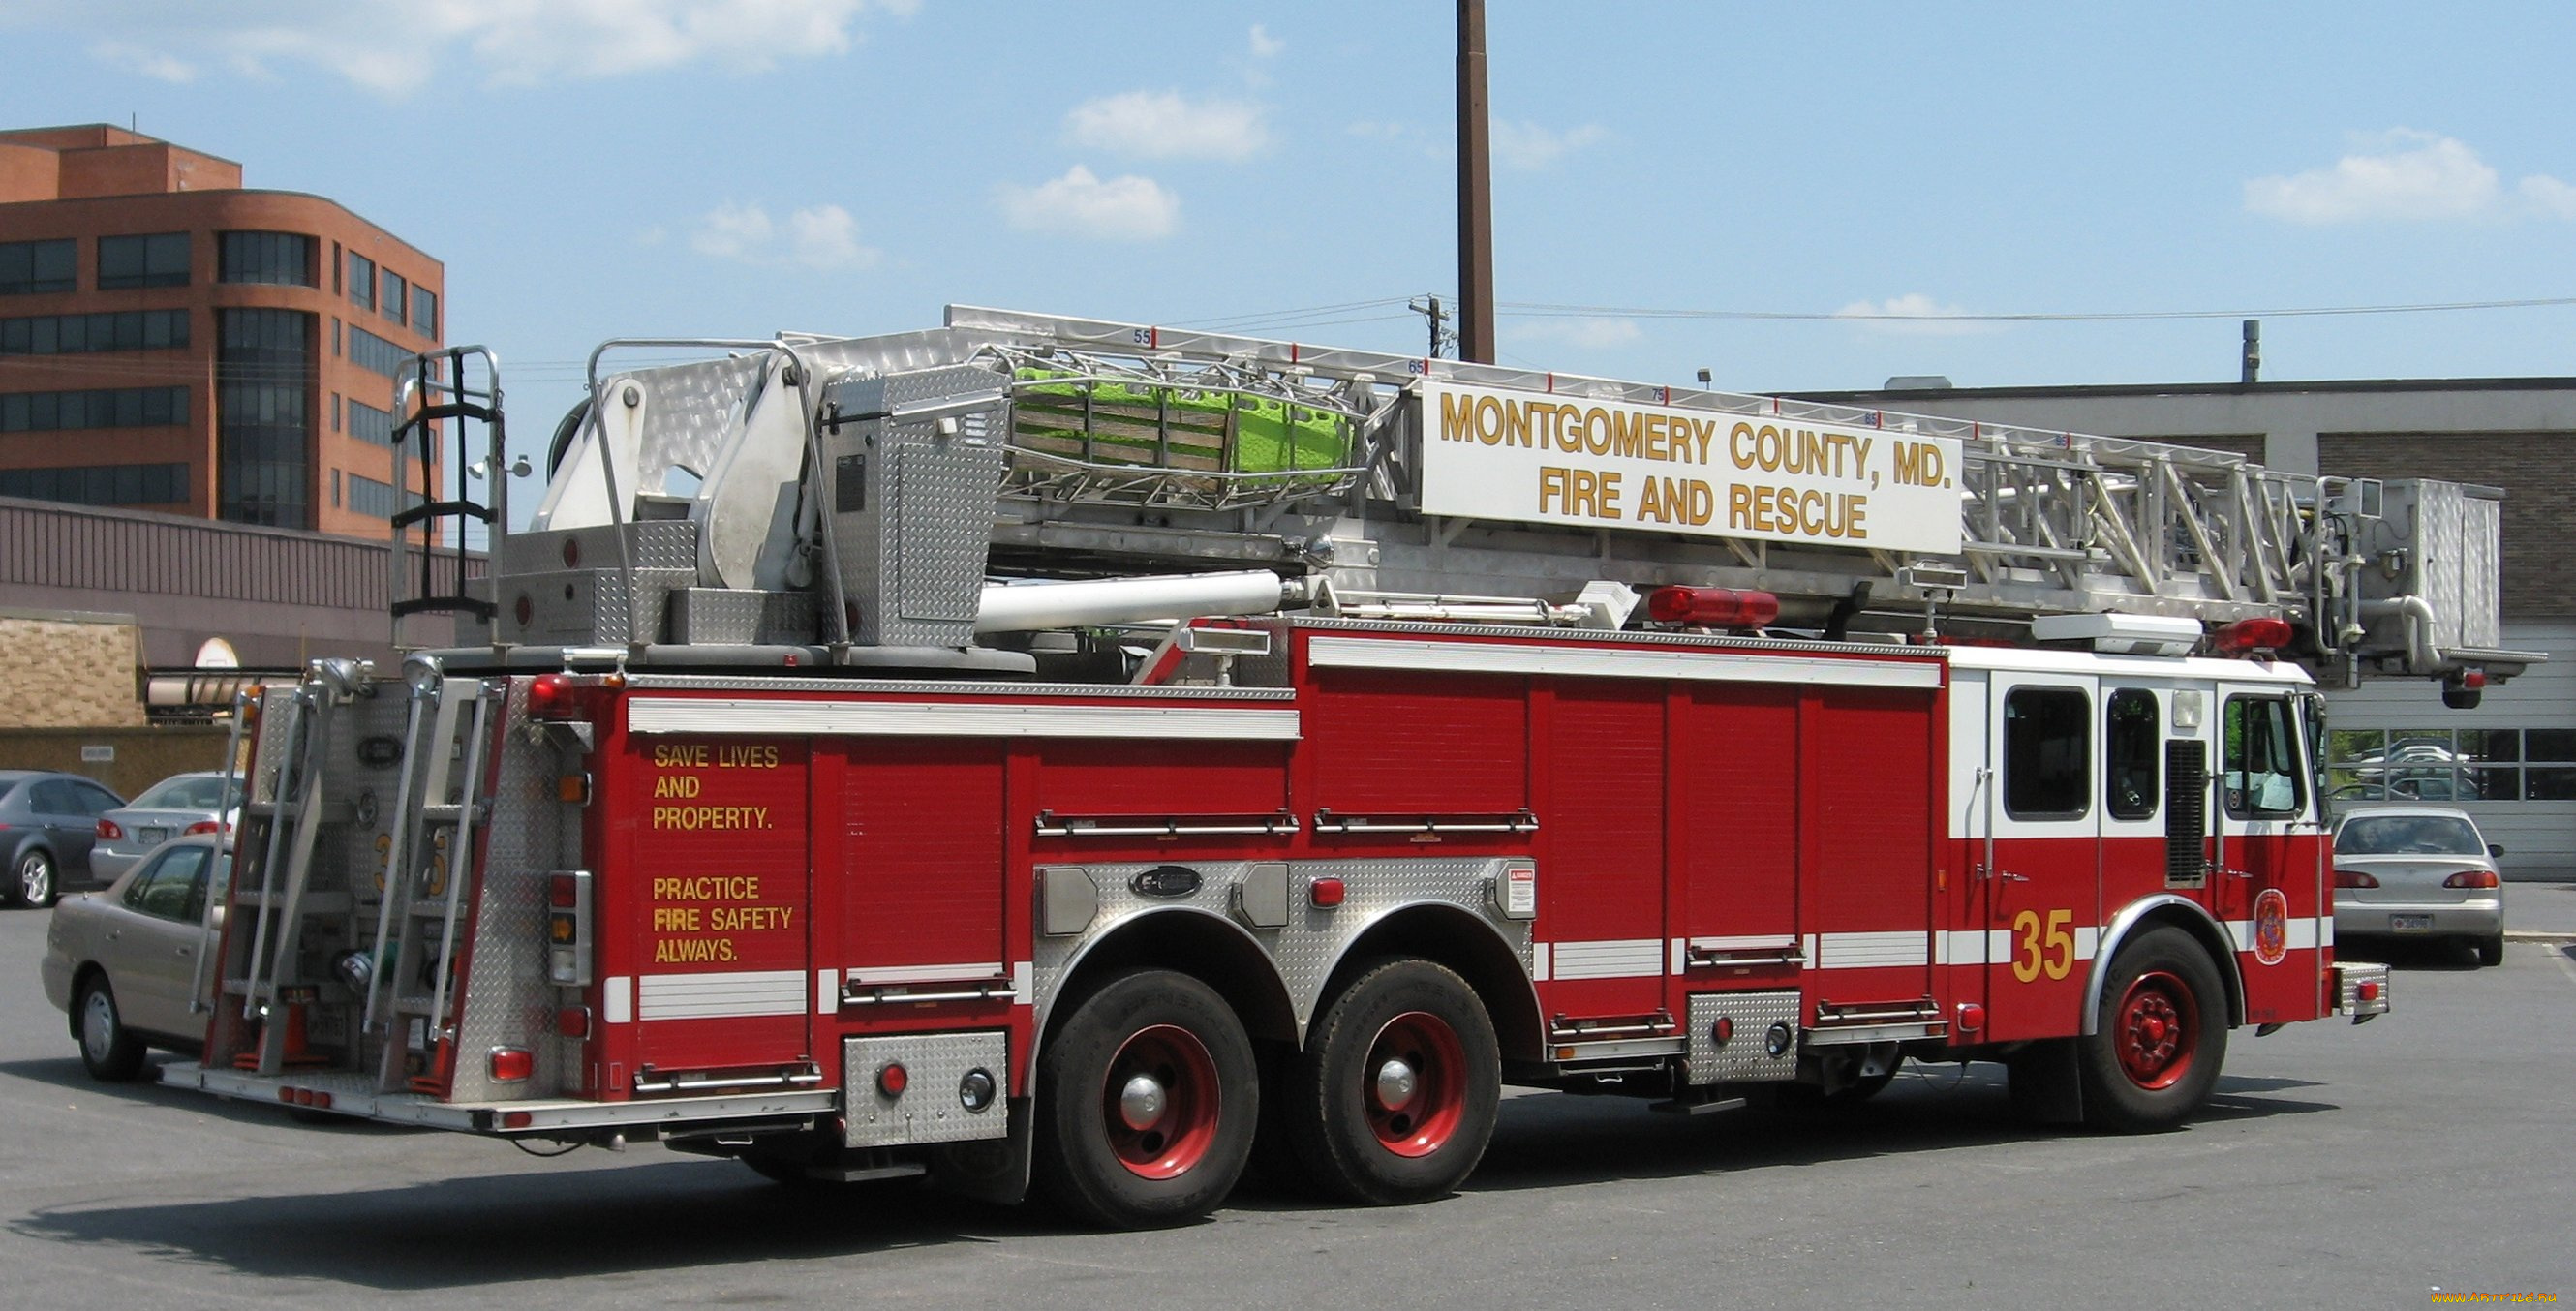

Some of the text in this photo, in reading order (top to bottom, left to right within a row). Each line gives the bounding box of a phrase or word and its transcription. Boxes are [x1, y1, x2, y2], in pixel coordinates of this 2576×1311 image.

[1133, 329, 1150, 344] 55
[1408, 360, 1424, 375] 65
[1651, 387, 1665, 401] 75
[1440, 391, 1951, 491] MONTGOMERY COUNTY, MD.
[1539, 466, 1867, 538] FIRE AND RESCUE
[654, 744, 779, 768] SAVE LIVES
[654, 776, 700, 798] AND
[653, 807, 773, 830] PROPERTY.
[653, 877, 760, 900] PRACTICE
[654, 907, 793, 931] FIRE SAFETY
[655, 938, 738, 963] ALWAYS.
[2012, 909, 2073, 983] 35
